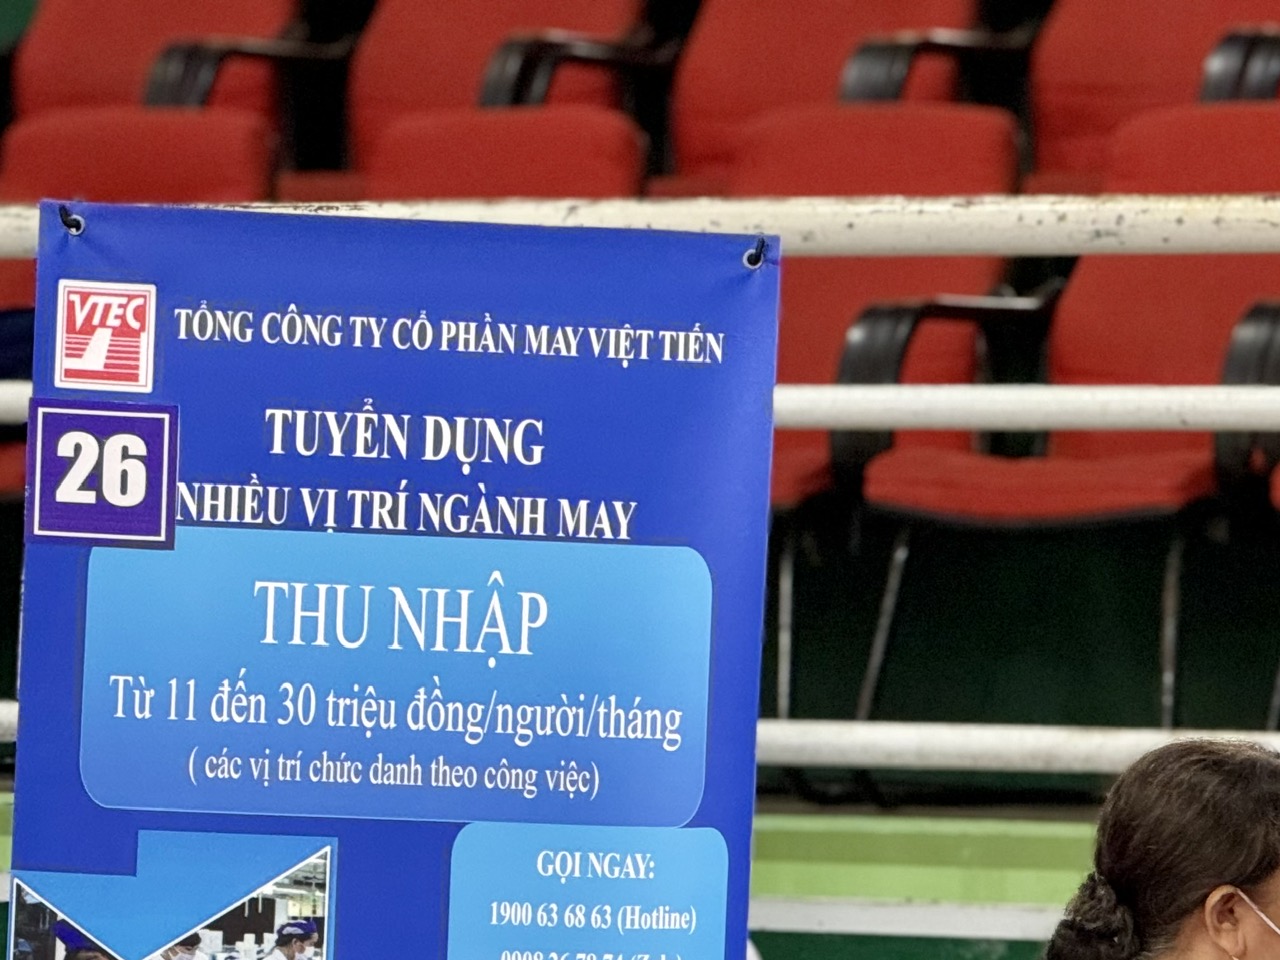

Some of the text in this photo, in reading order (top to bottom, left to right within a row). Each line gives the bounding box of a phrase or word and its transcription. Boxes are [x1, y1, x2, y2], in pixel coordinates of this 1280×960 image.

[69, 294, 145, 331] VTEC
[175, 301, 724, 368] TỔNG CÔNG TY CỔ PHẦN MAY VIỆT TIẾN
[55, 431, 148, 507] 26
[266, 398, 544, 475] TUYỂN DỤNG
[176, 469, 637, 539] NHIỀU VỊ TRÍ NGÀNH MAY
[254, 570, 547, 668] THU NHẬP
[110, 668, 682, 751] Từ 11 đến 30 triệu đồng/người/tháng
[250, 749, 599, 799] vị trí chức danh theo công việc)
[537, 851, 654, 884] GỌI NGAY:
[491, 902, 696, 934] 1900 63 68 63 (Hotline)
